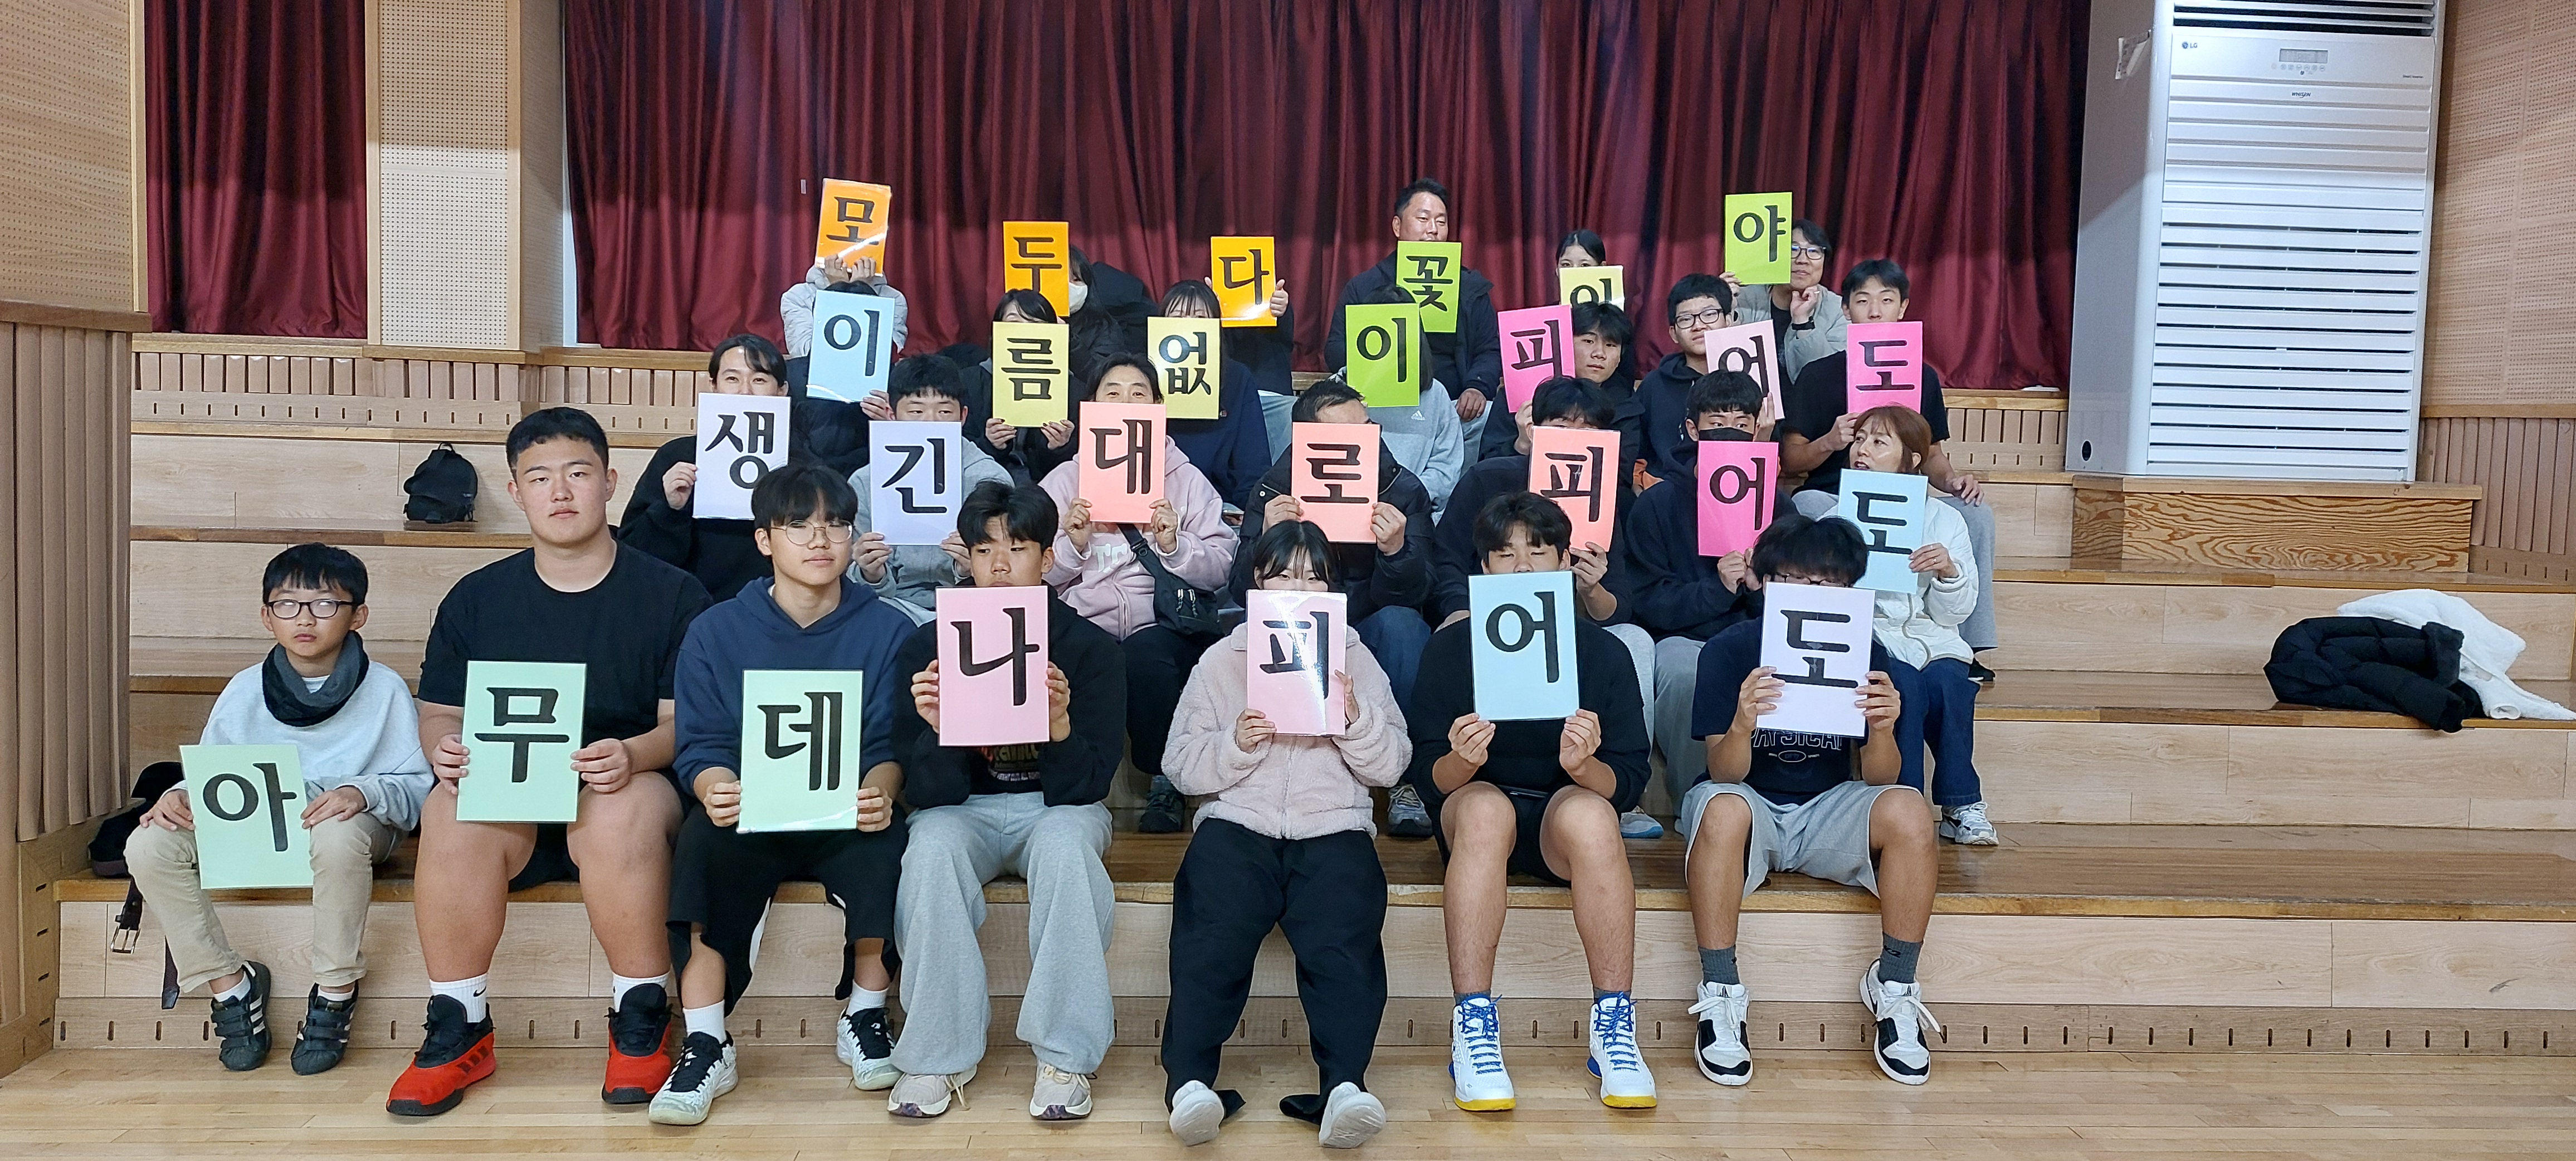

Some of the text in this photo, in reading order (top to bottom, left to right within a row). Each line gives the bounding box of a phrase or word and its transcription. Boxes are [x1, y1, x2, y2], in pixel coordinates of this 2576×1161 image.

[827, 196, 875, 245] 모
[1734, 205, 1786, 262] 야
[1010, 237, 1063, 290] 두
[1218, 249, 1270, 305] 다
[1403, 256, 1453, 311] 꽃
[824, 310, 880, 376] 이
[1001, 338, 1061, 401] 름
[1159, 331, 1211, 396] 없
[1357, 318, 1407, 382] 이
[1510, 319, 1560, 377] 피
[1719, 335, 1769, 398] 어
[1856, 340, 1915, 391] 도
[705, 412, 774, 489] 생
[882, 438, 947, 513] 긴
[1089, 419, 1152, 494] 대
[1300, 443, 1369, 504] 로
[1541, 446, 1603, 522] 피
[1710, 457, 1765, 530] 어
[1852, 491, 1912, 554] 도
[950, 607, 1040, 706] 나
[1260, 611, 1329, 699] 피
[1486, 591, 1559, 683] 어
[1771, 609, 1858, 689] 도
[475, 687, 569, 783] 무
[757, 692, 842, 791] 데
[203, 763, 297, 851] 아
